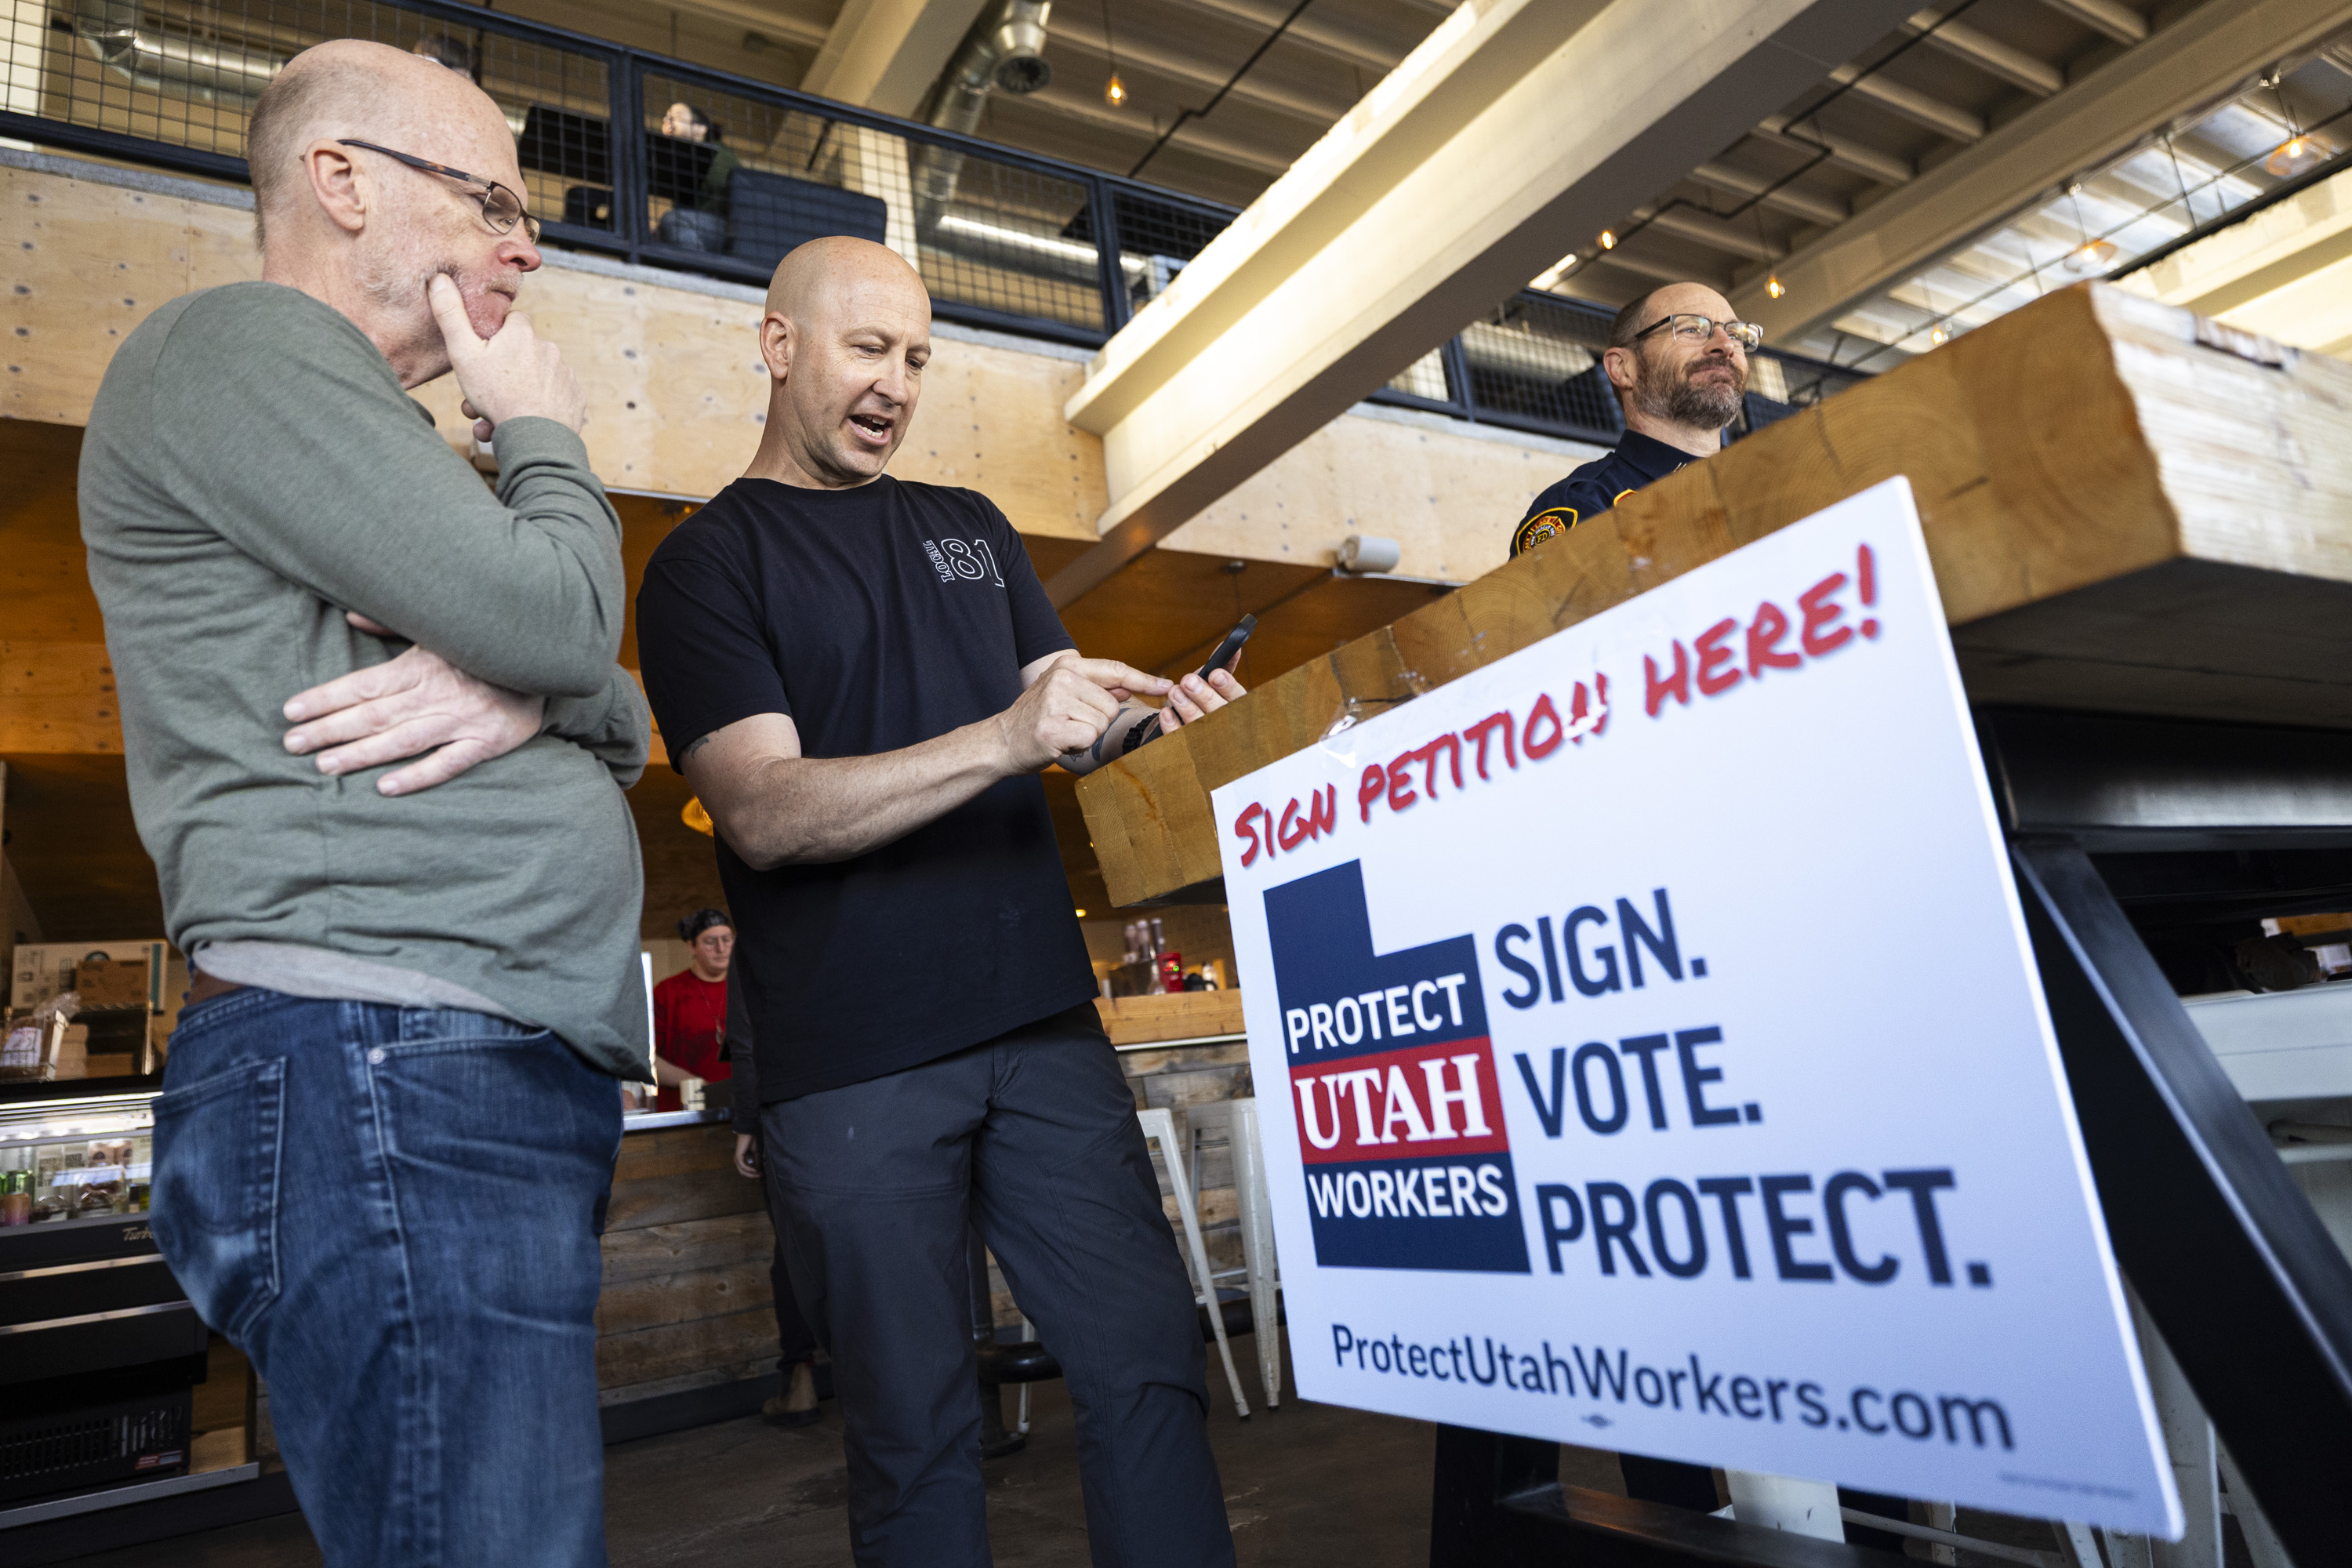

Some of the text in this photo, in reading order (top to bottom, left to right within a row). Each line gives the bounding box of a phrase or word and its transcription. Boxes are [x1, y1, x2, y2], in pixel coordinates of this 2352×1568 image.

[941, 538, 1005, 588] 81
[1234, 783, 1336, 868] SIGN
[1644, 543, 1878, 718] HERE!
[1494, 887, 1708, 1010] SIGN.
[1286, 972, 1466, 1054] PROTECT
[1294, 1053, 1493, 1149] UTAH
[1513, 1025, 1762, 1138] VOTE.
[1308, 1163, 1508, 1218] WORKERS
[1534, 1167, 1993, 1288] PROTECT.
[1331, 1323, 2017, 1452] ProtectUtahWorkers.com
